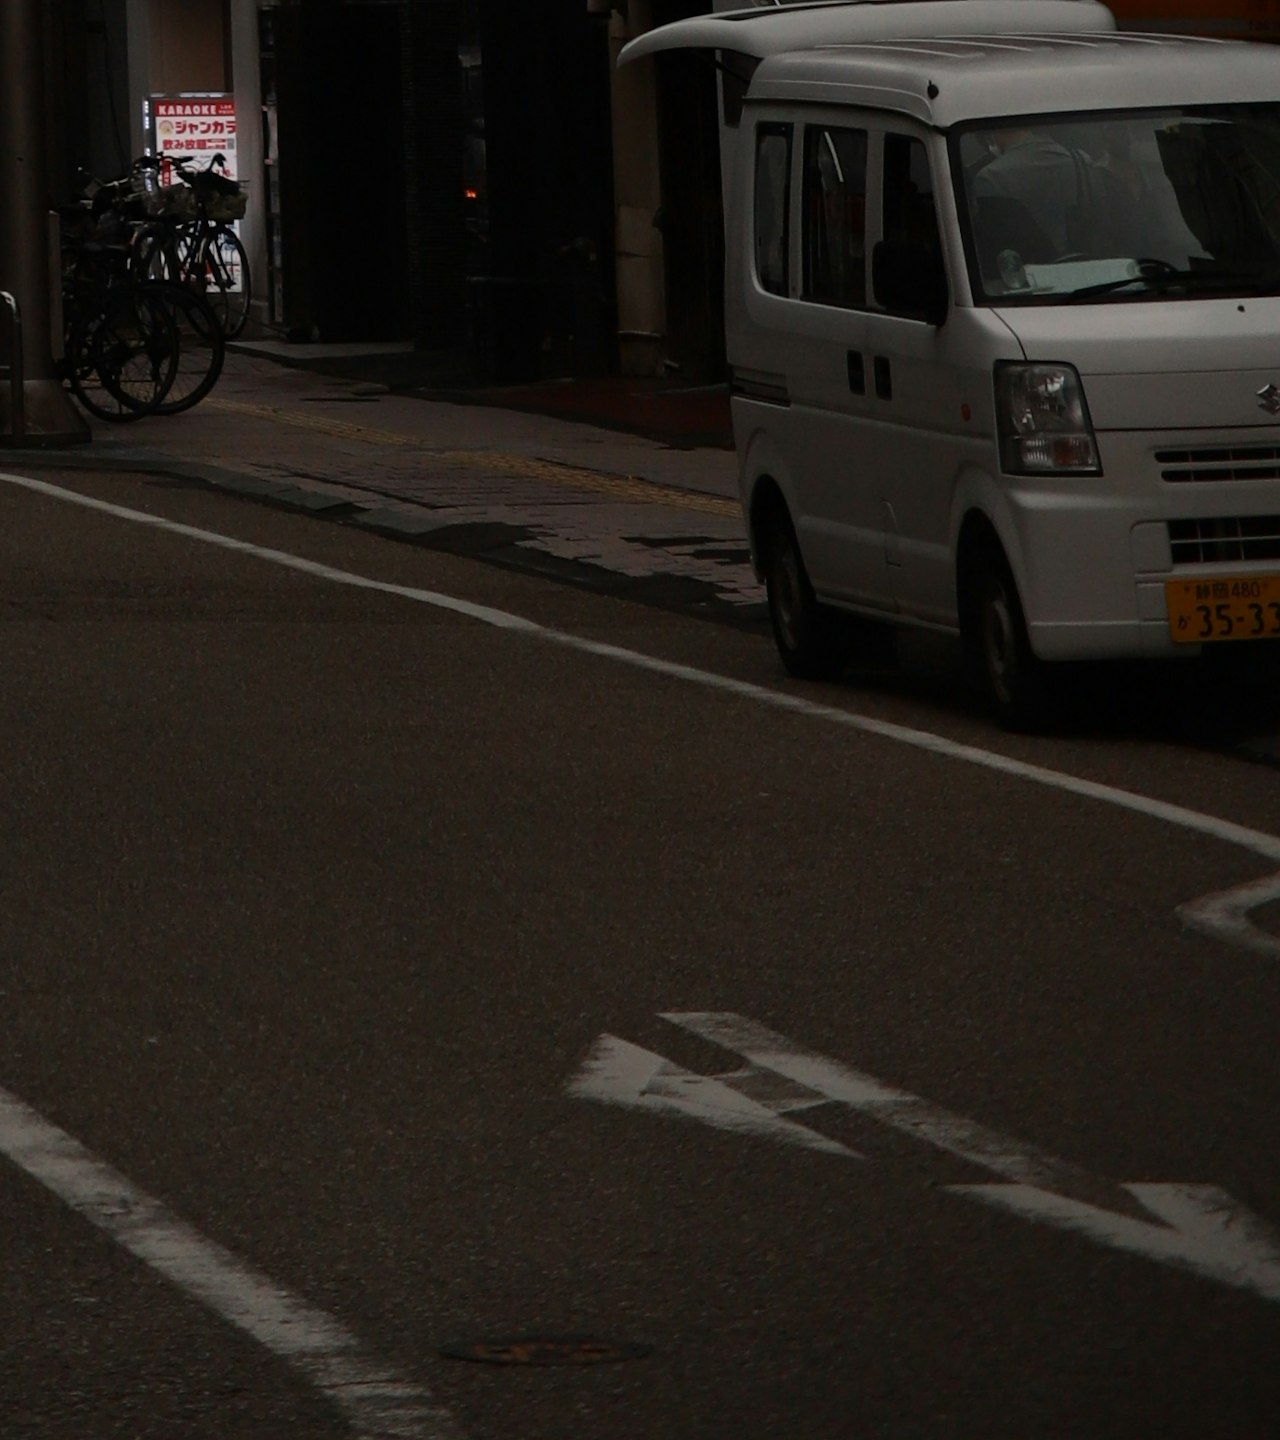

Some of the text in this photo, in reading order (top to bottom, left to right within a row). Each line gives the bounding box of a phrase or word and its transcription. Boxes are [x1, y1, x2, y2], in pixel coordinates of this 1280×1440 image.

[157, 103, 217, 116] KARAOKE
[173, 119, 237, 136] ジャンカラ
